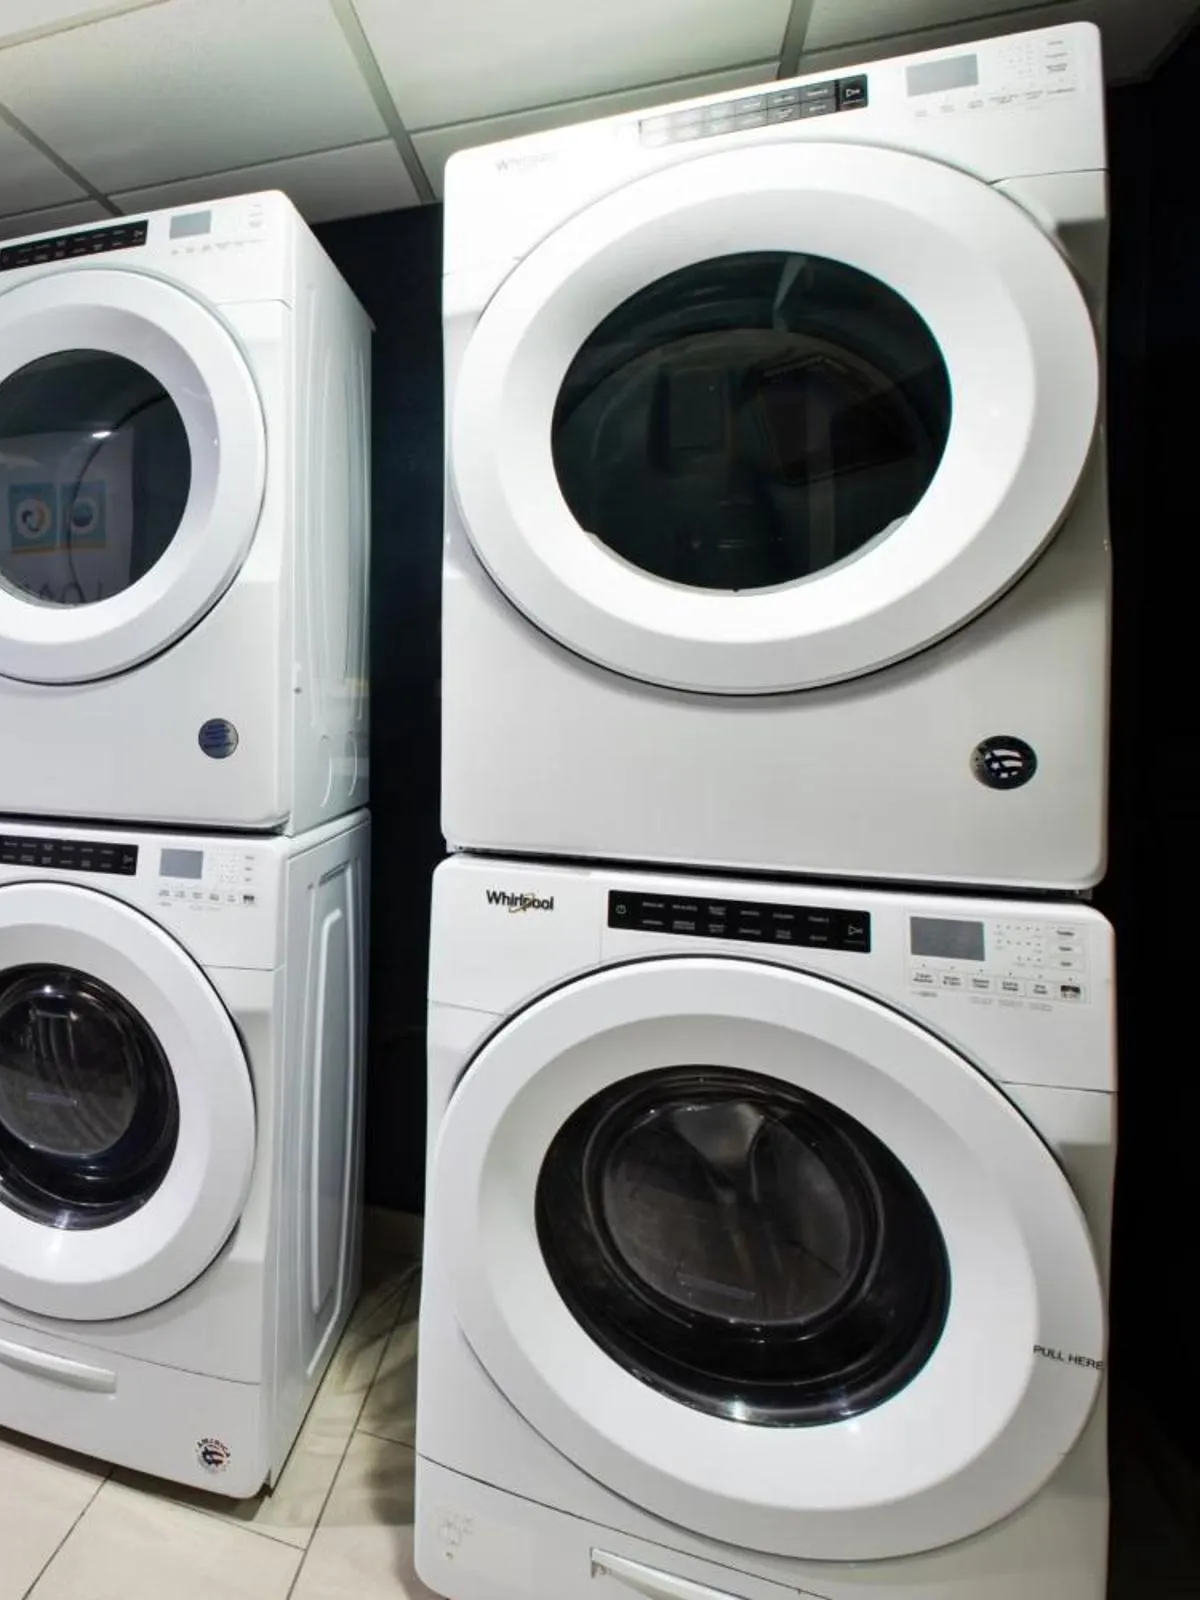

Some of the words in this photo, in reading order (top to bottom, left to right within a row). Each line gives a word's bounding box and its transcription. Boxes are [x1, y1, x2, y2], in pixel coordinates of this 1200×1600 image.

[486, 889, 554, 913] Whirlpool
[1033, 1344, 1064, 1362] PULL
[1068, 1353, 1104, 1370] HERE
